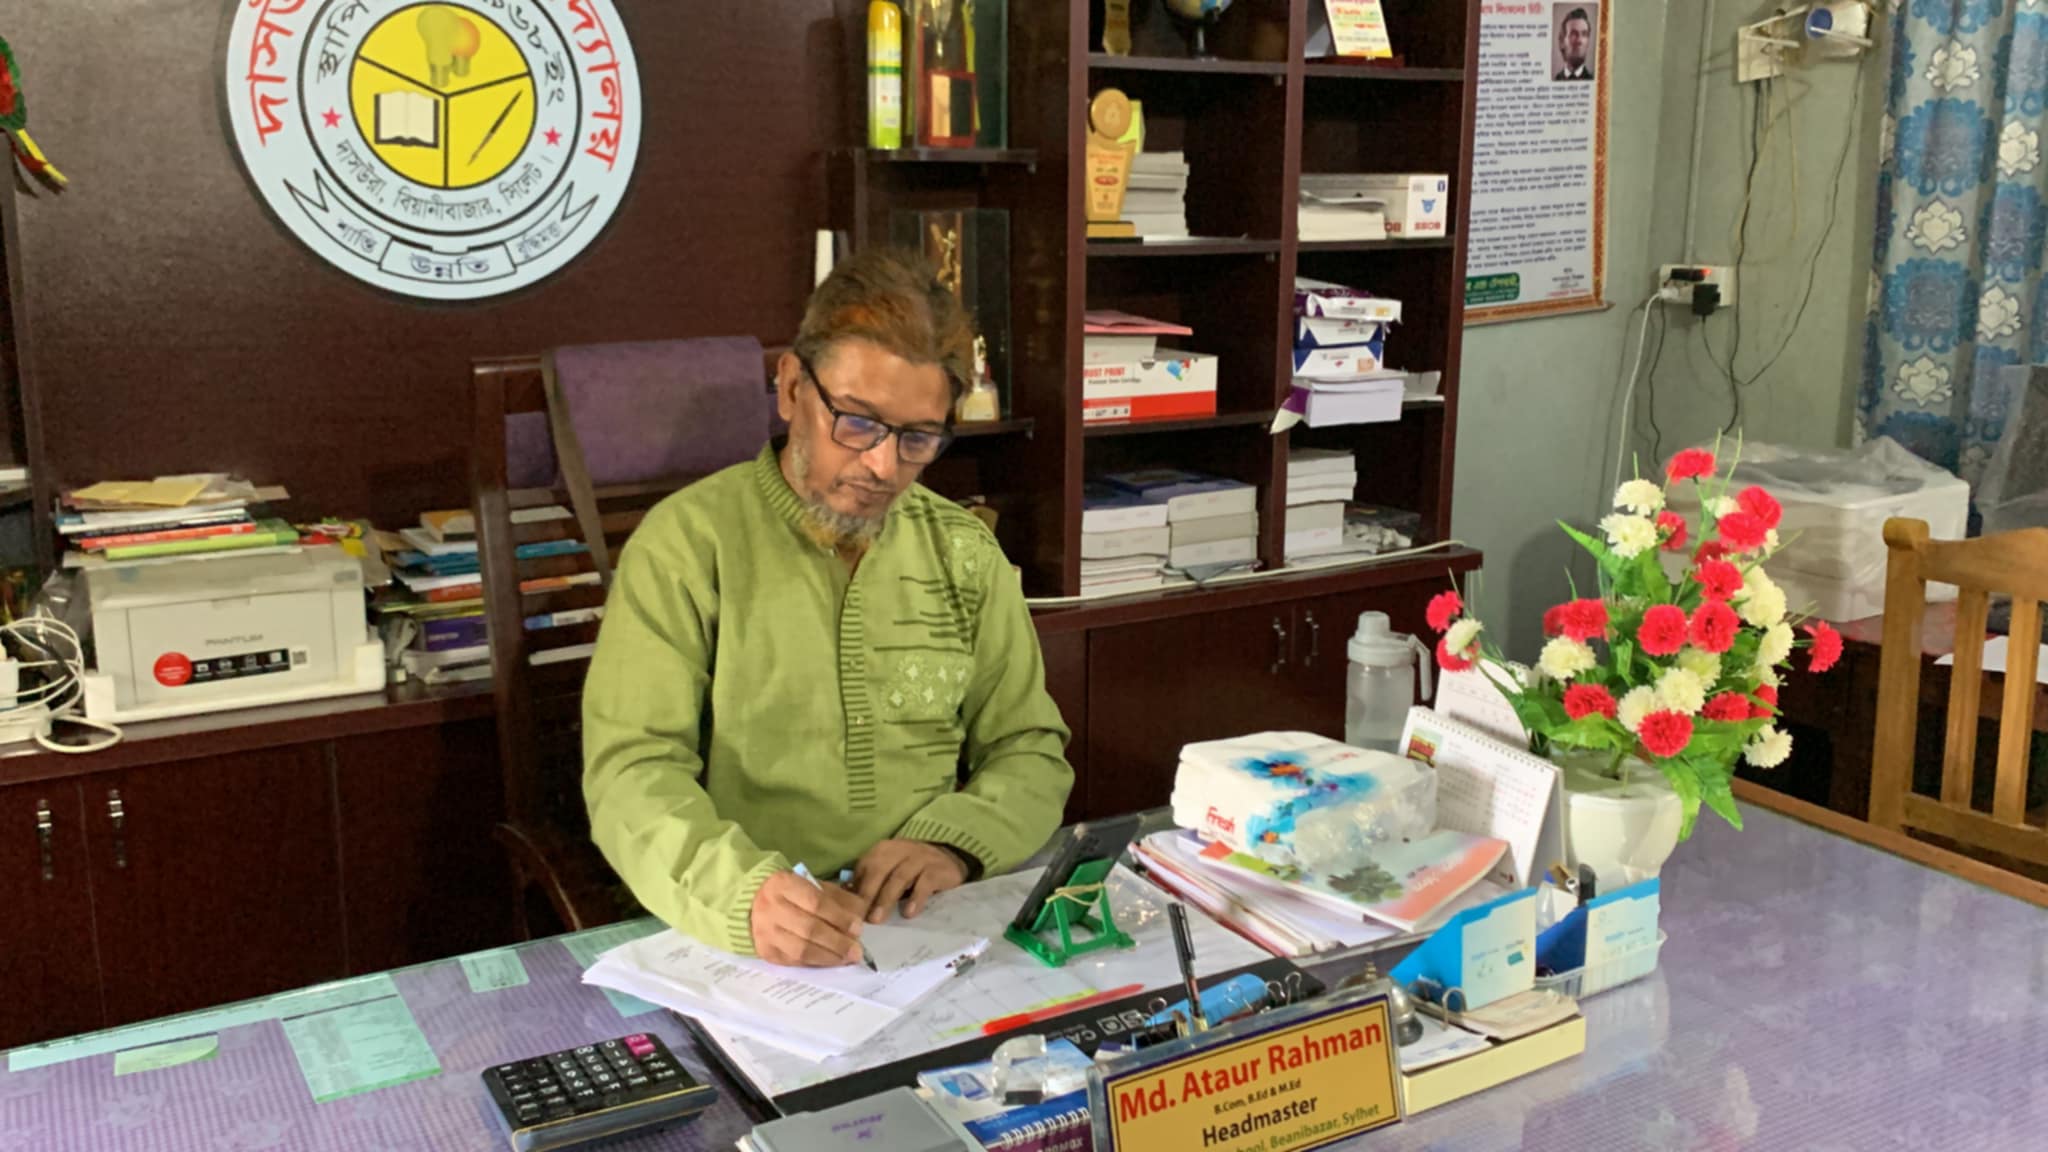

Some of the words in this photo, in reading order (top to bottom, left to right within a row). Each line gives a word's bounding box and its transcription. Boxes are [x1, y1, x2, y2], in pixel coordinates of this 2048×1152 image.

[409, 252, 490, 279] উন্নতি
[1206, 806, 1235, 834] Fresh
[1120, 1079, 1176, 1123] Md.
[1182, 1057, 1261, 1103] Ataur
[1268, 1023, 1382, 1075] Rahman
[1278, 1079, 1302, 1095] M.Ed
[1202, 1096, 1318, 1147] Headmaster
[1269, 1117, 1341, 1150] Beanibazar,
[1341, 1103, 1380, 1125] Sylhet
